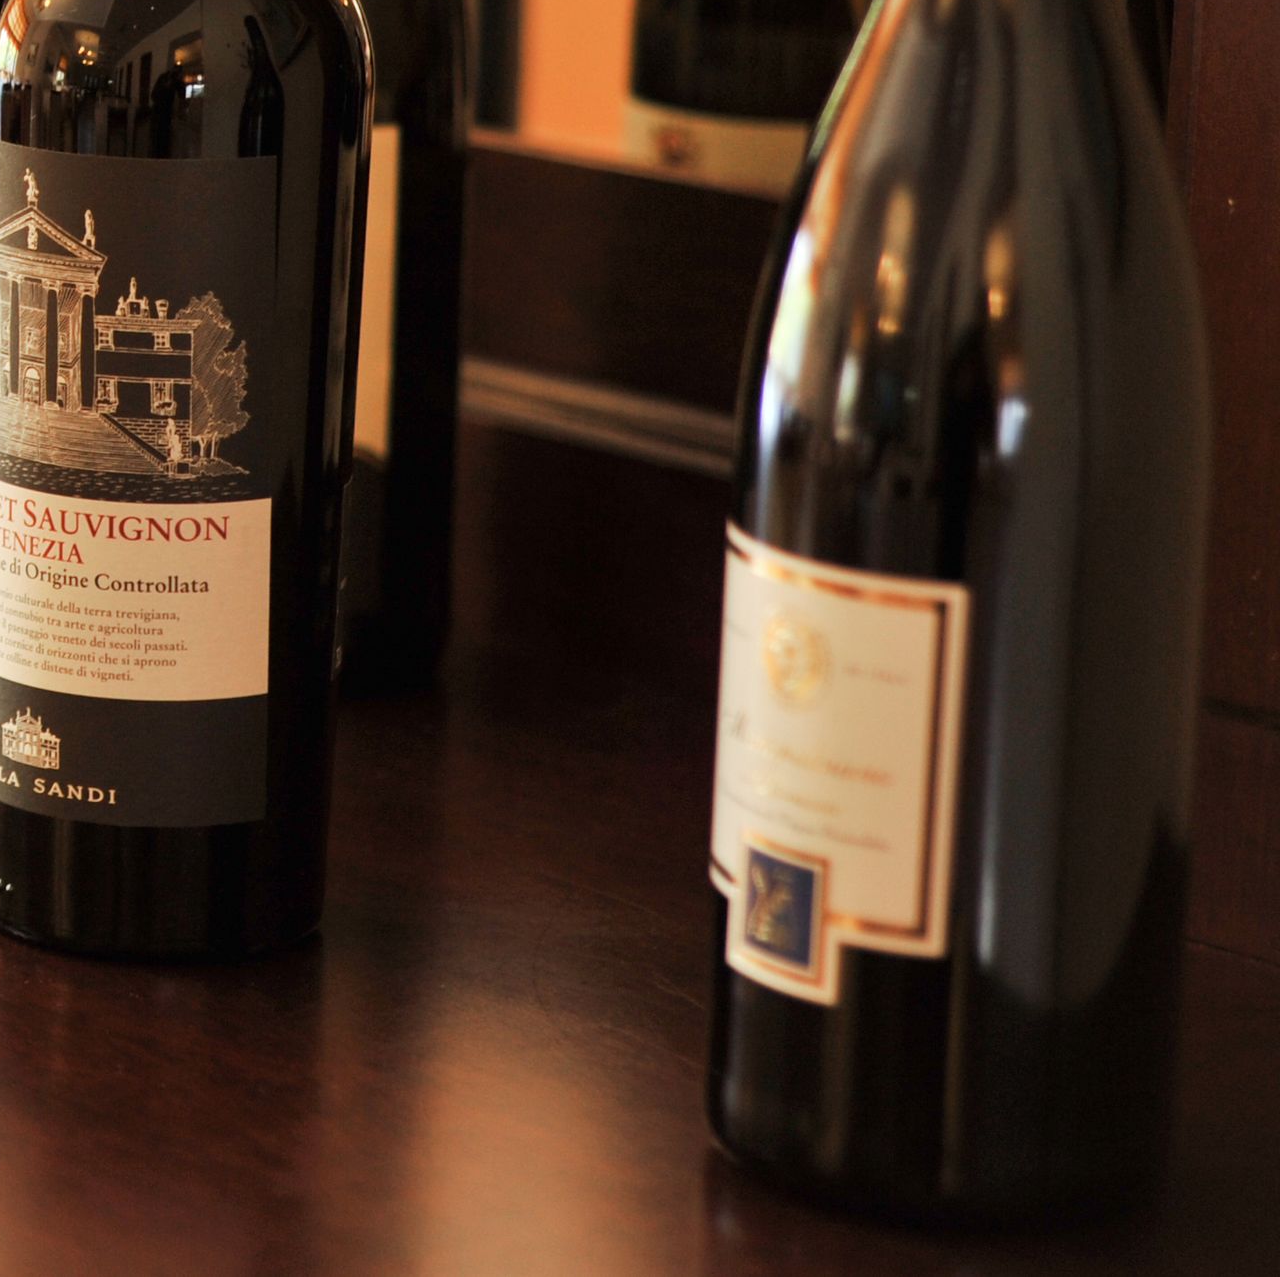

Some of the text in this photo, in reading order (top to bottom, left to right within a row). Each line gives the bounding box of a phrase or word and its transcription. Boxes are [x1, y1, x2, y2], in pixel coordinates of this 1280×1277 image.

[23, 498, 231, 542] SAUVIGNON
[9, 557, 22, 576] di
[25, 562, 89, 590] Origine
[94, 573, 210, 595] Controllata
[14, 593, 55, 611] culturale
[56, 601, 81, 614] della
[83, 606, 112, 618] terra
[115, 608, 181, 623] trevigiana,
[7, 622, 49, 640] paesaggio
[52, 633, 87, 646] veneto
[89, 636, 106, 648] dei
[109, 639, 141, 651] secoli
[144, 640, 188, 655] passati.
[47, 616, 62, 627] tra
[63, 620, 87, 631] arte
[88, 623, 95, 631] e
[97, 623, 164, 636] agricoltura
[33, 661, 39, 669] e
[41, 659, 73, 676] distese
[76, 665, 87, 677] di
[90, 667, 134, 682] vigneti.
[35, 642, 45, 655] di
[46, 647, 96, 663] orizzonti
[98, 653, 119, 665] che
[121, 654, 130, 666] si
[133, 658, 177, 670] aprono
[32, 777, 118, 805] SANDI
